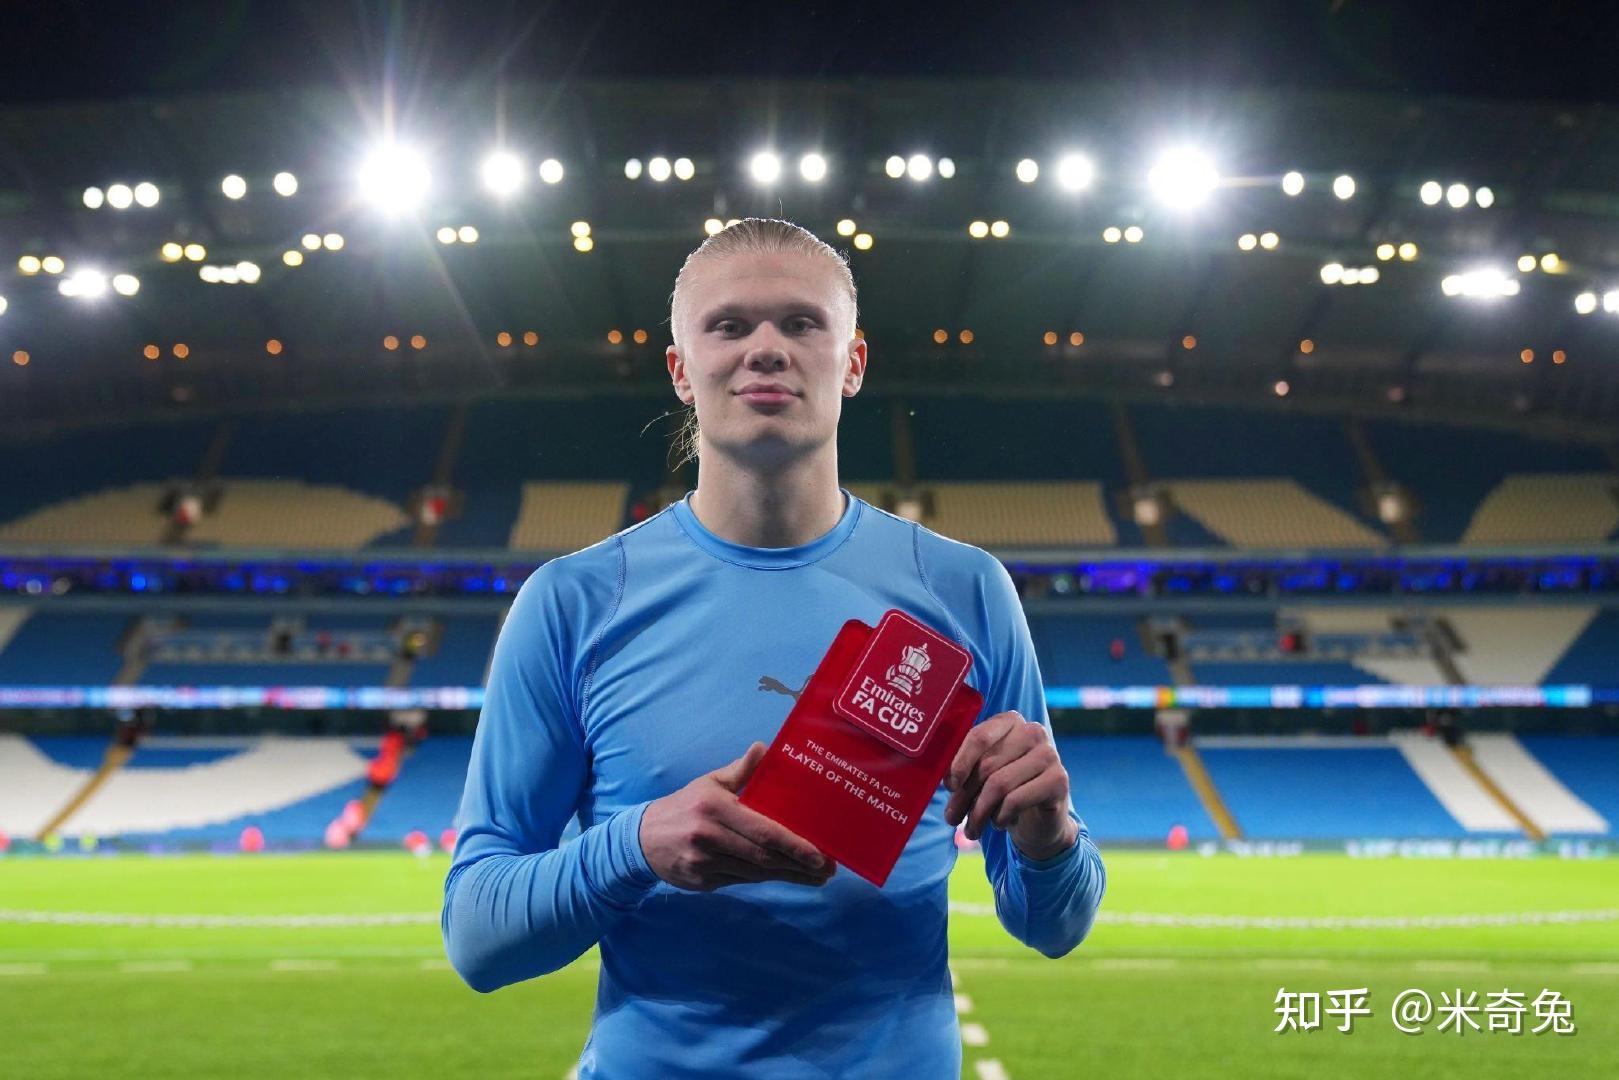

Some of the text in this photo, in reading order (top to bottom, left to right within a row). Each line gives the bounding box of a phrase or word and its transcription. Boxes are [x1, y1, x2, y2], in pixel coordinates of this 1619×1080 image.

[851, 692, 919, 735] FA CUP
[860, 676, 925, 722] Emirates
[782, 744, 908, 824] PLAYER OF THE MATCH
[806, 740, 901, 800] THE EMIRATES FA CUP
